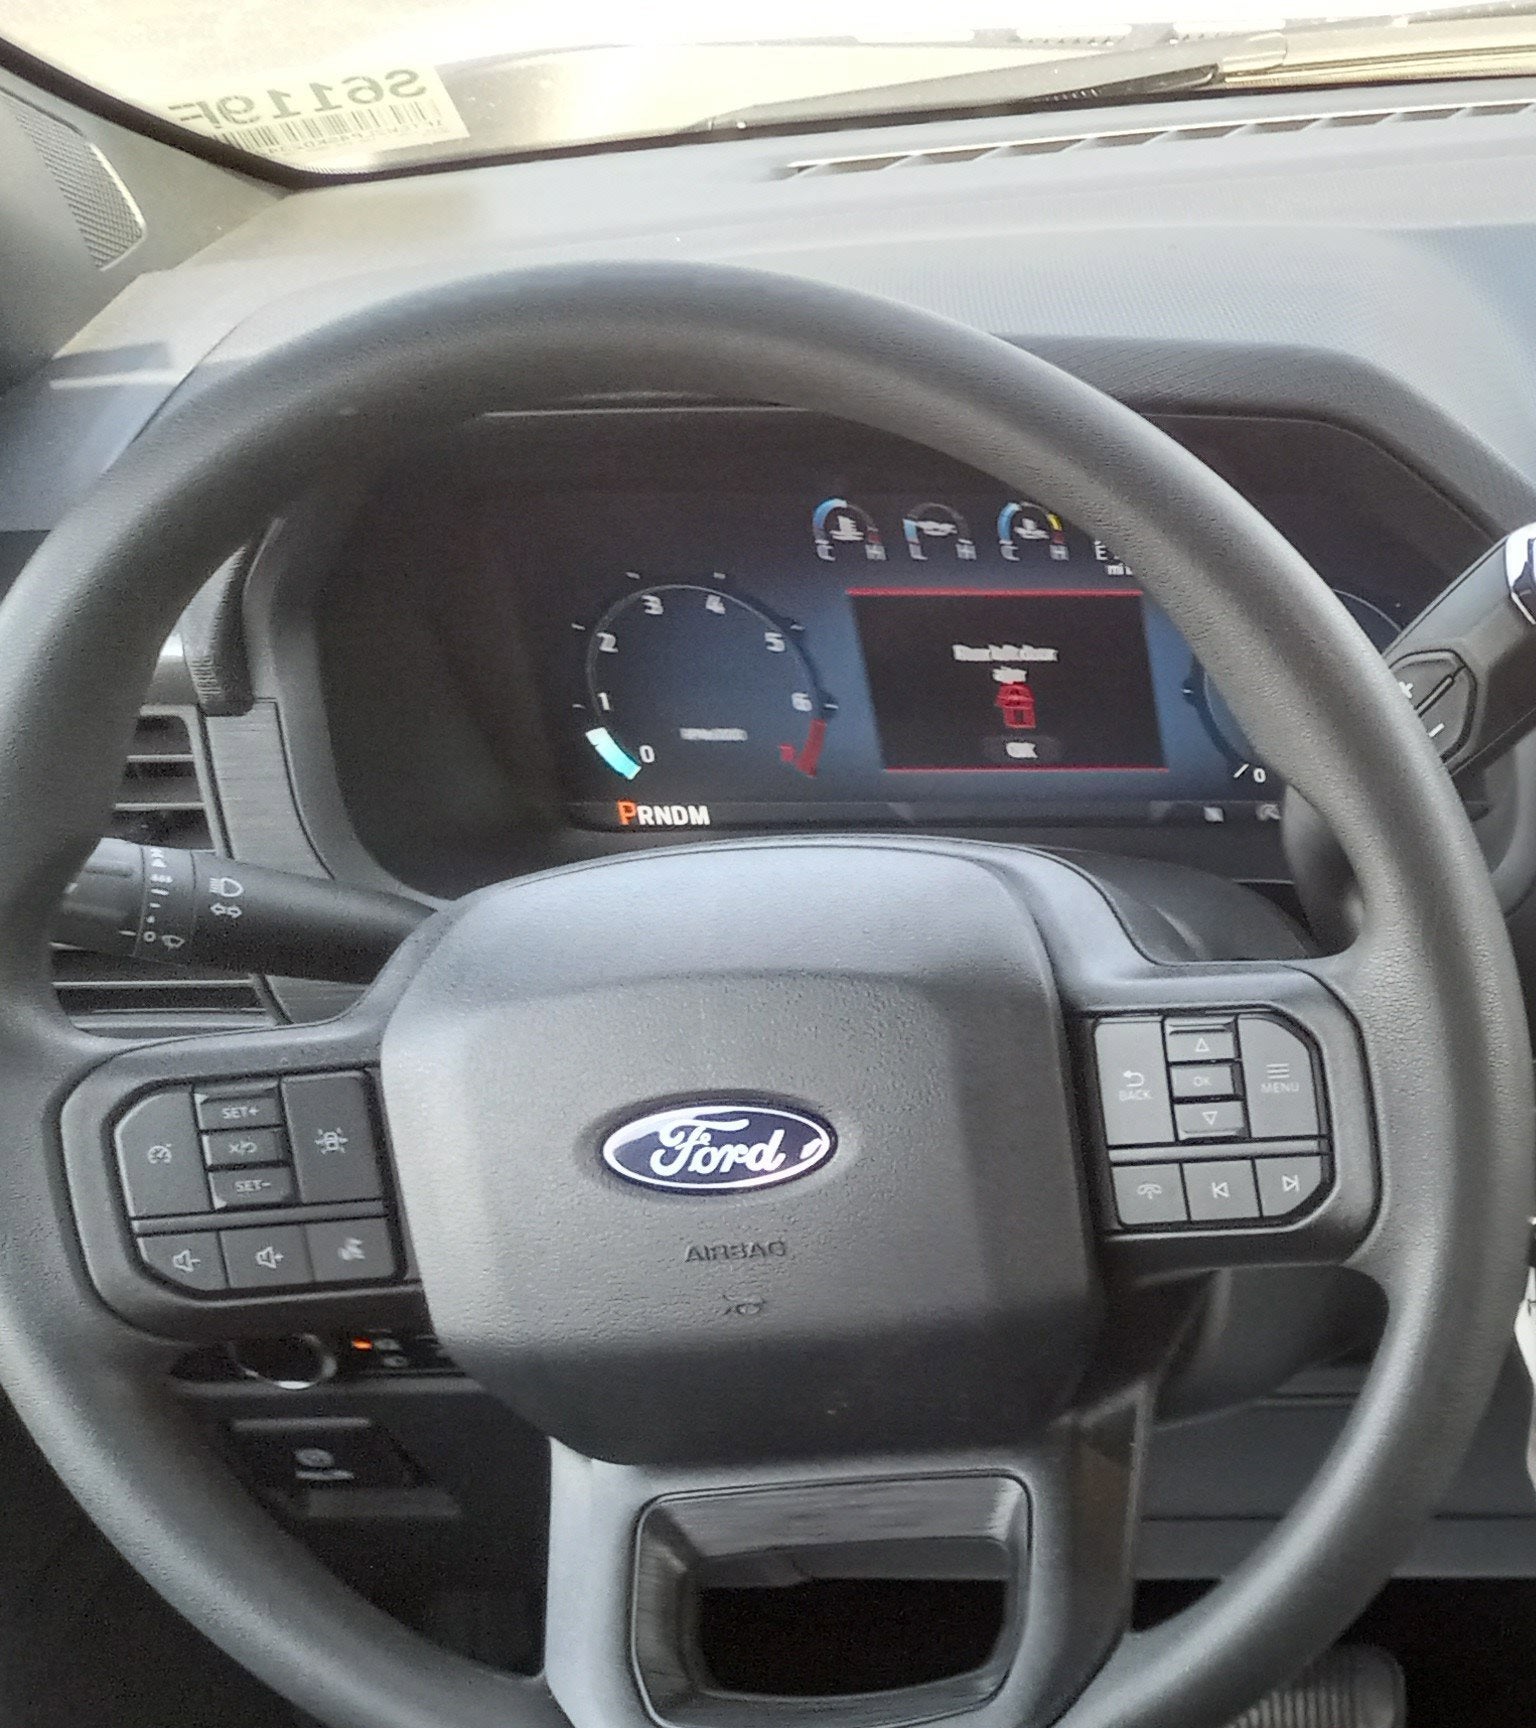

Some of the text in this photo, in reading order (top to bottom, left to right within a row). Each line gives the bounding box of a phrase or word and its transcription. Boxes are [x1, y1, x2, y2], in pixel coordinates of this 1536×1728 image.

[641, 595, 664, 615] 3
[705, 595, 726, 615] 4
[597, 632, 619, 653] 2
[764, 632, 785, 652] 5
[598, 692, 611, 711] 1
[791, 692, 812, 712] 6
[639, 745, 655, 763] 0
[1253, 767, 1267, 783] 0
[617, 799, 710, 826] PRNDM
[1193, 1076, 1213, 1087] OK
[1260, 1082, 1299, 1093] MENU
[1118, 1089, 1153, 1101] BACK
[221, 1105, 259, 1119] SET+
[650, 1118, 786, 1177] Ford
[235, 1179, 271, 1193] SET-
[685, 1241, 787, 1263] AIRBAG
